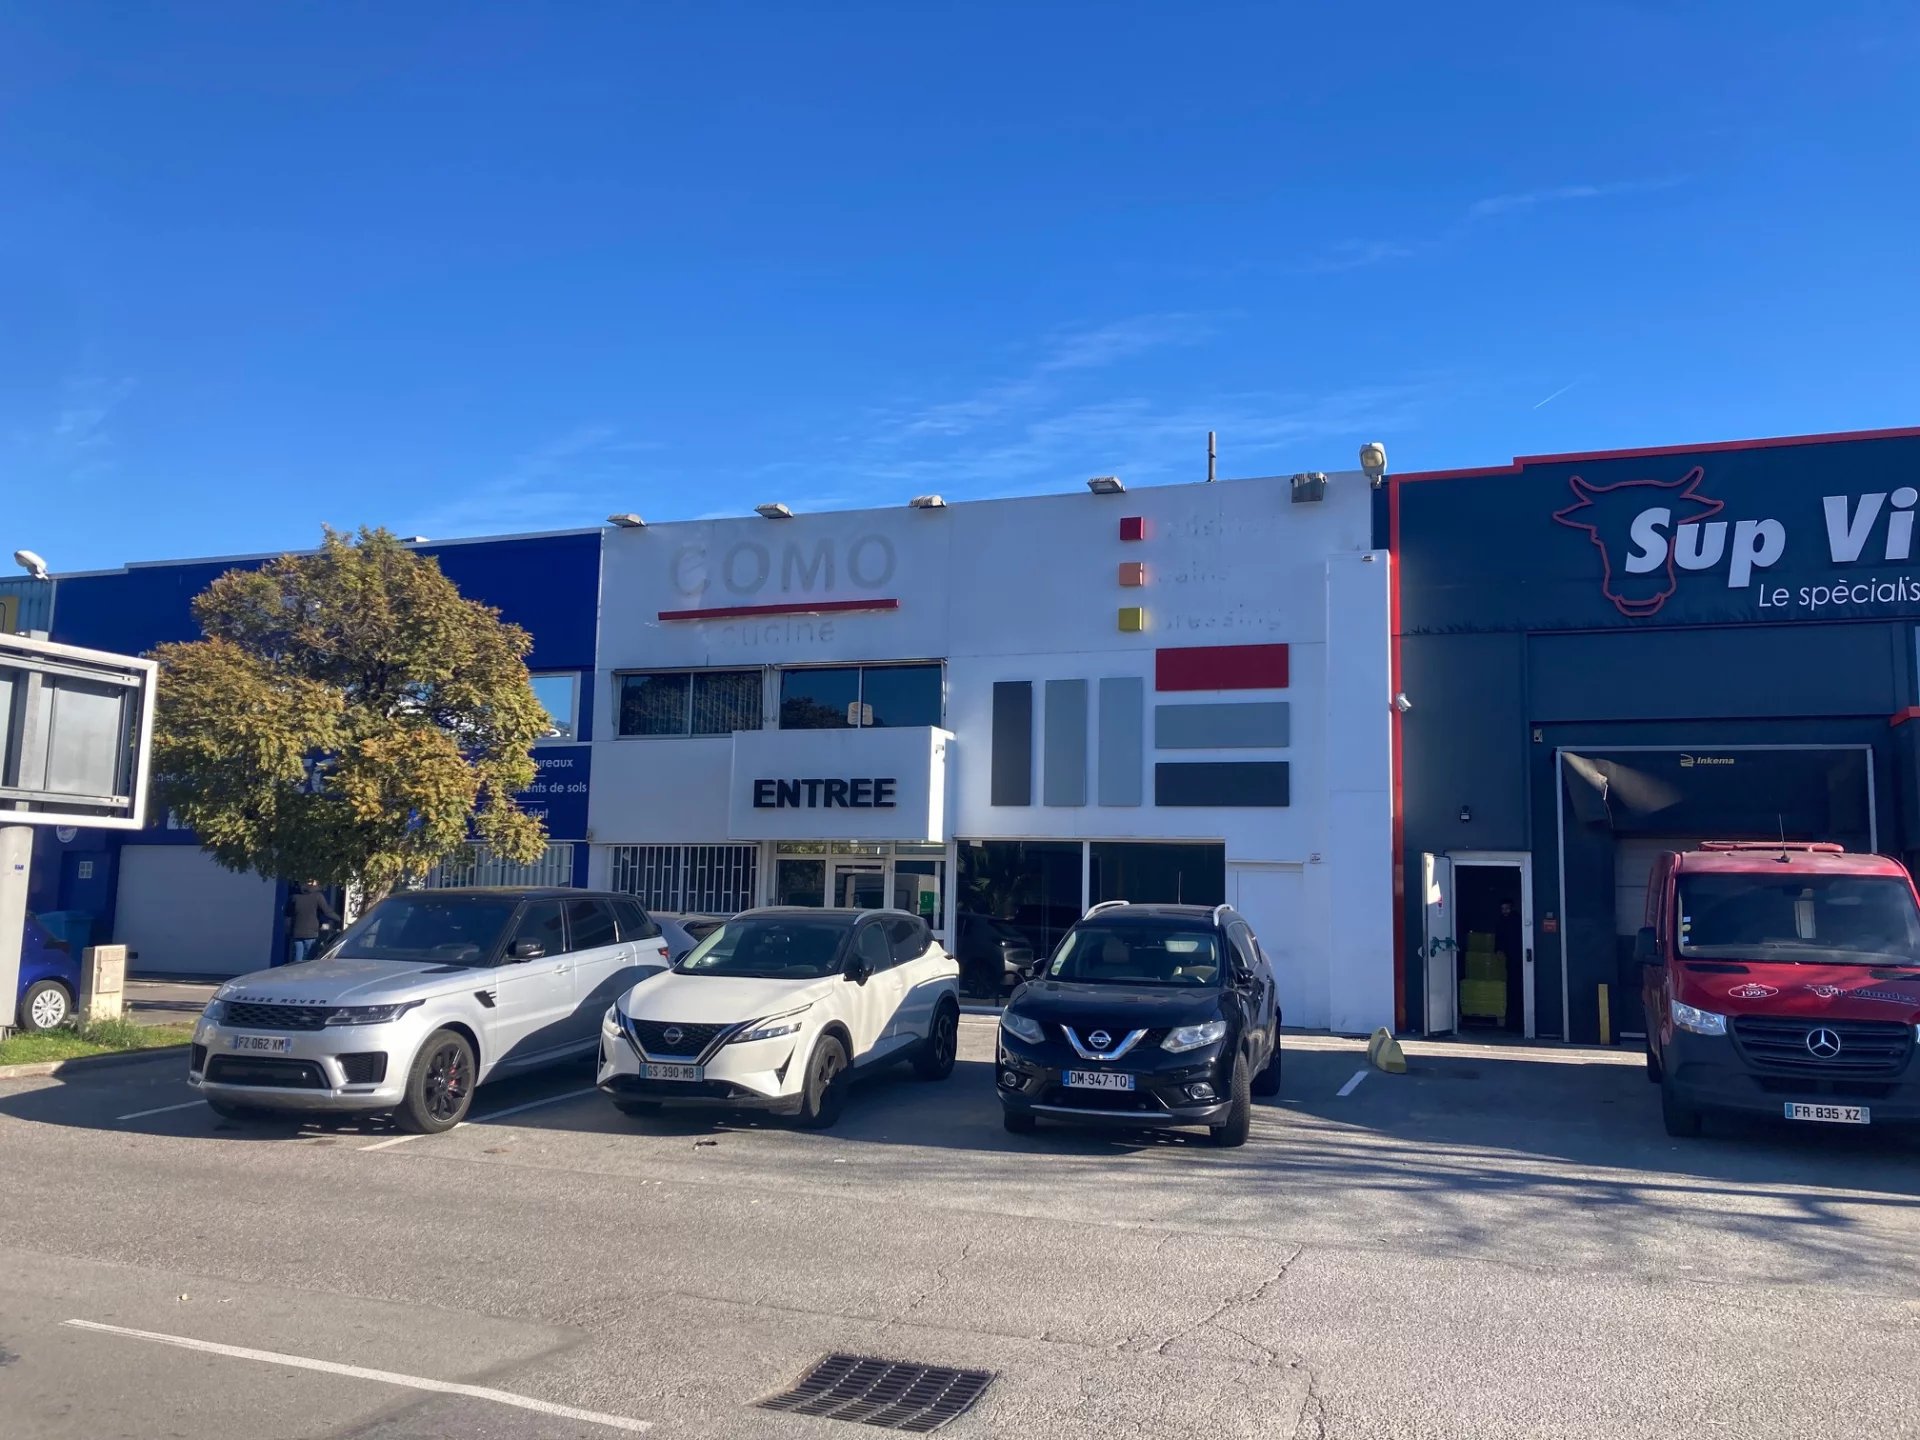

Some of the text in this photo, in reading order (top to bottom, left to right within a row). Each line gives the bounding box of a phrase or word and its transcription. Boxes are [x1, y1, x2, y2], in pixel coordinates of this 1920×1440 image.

[1625, 487, 1918, 588] Sup Vi
[669, 532, 898, 597] COMO
[1759, 583, 1790, 608] Le
[535, 759, 574, 768] ureaux
[1696, 757, 1735, 765] Inkema
[549, 782, 565, 793] de
[566, 781, 588, 793] sols
[752, 778, 897, 808] ENTREE
